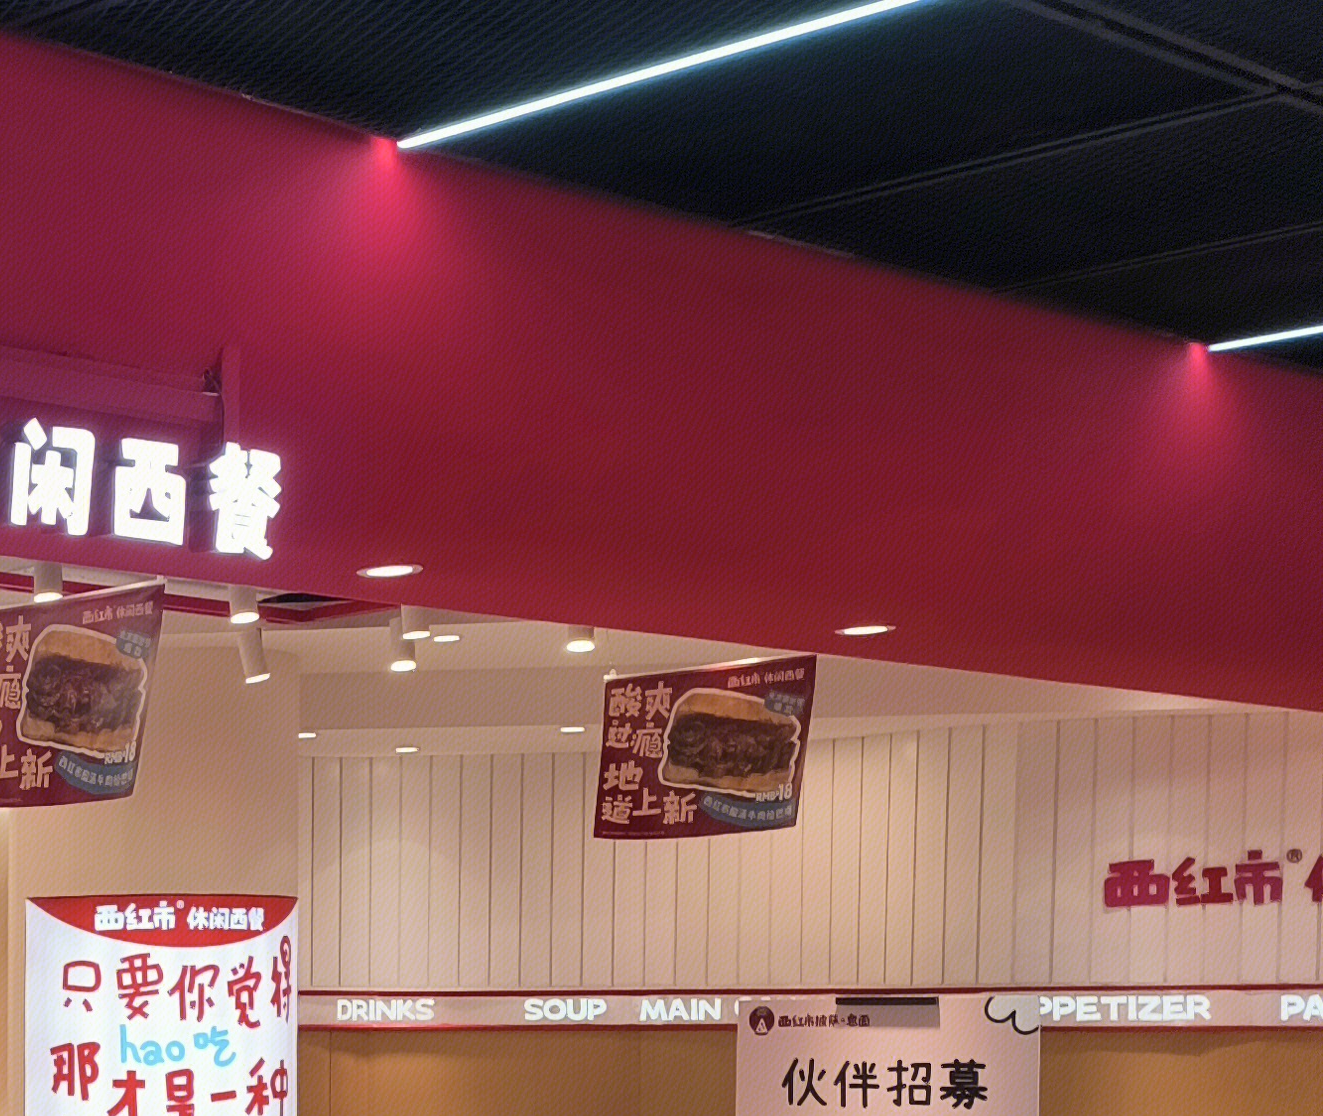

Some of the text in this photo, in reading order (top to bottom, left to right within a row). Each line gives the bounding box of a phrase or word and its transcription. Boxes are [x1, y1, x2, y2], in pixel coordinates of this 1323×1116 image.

[607, 681, 673, 720] 酸爽
[606, 719, 664, 759] 过瘾
[1103, 849, 1284, 908] 西红市
[93, 901, 176, 931] 西红市
[336, 997, 435, 1022] DRINKS
[523, 997, 607, 1021] SOUP
[639, 997, 723, 1022] MAIN
[1039, 994, 1212, 1022] PPETIZER
[781, 1056, 989, 1110] 伙伴招募
